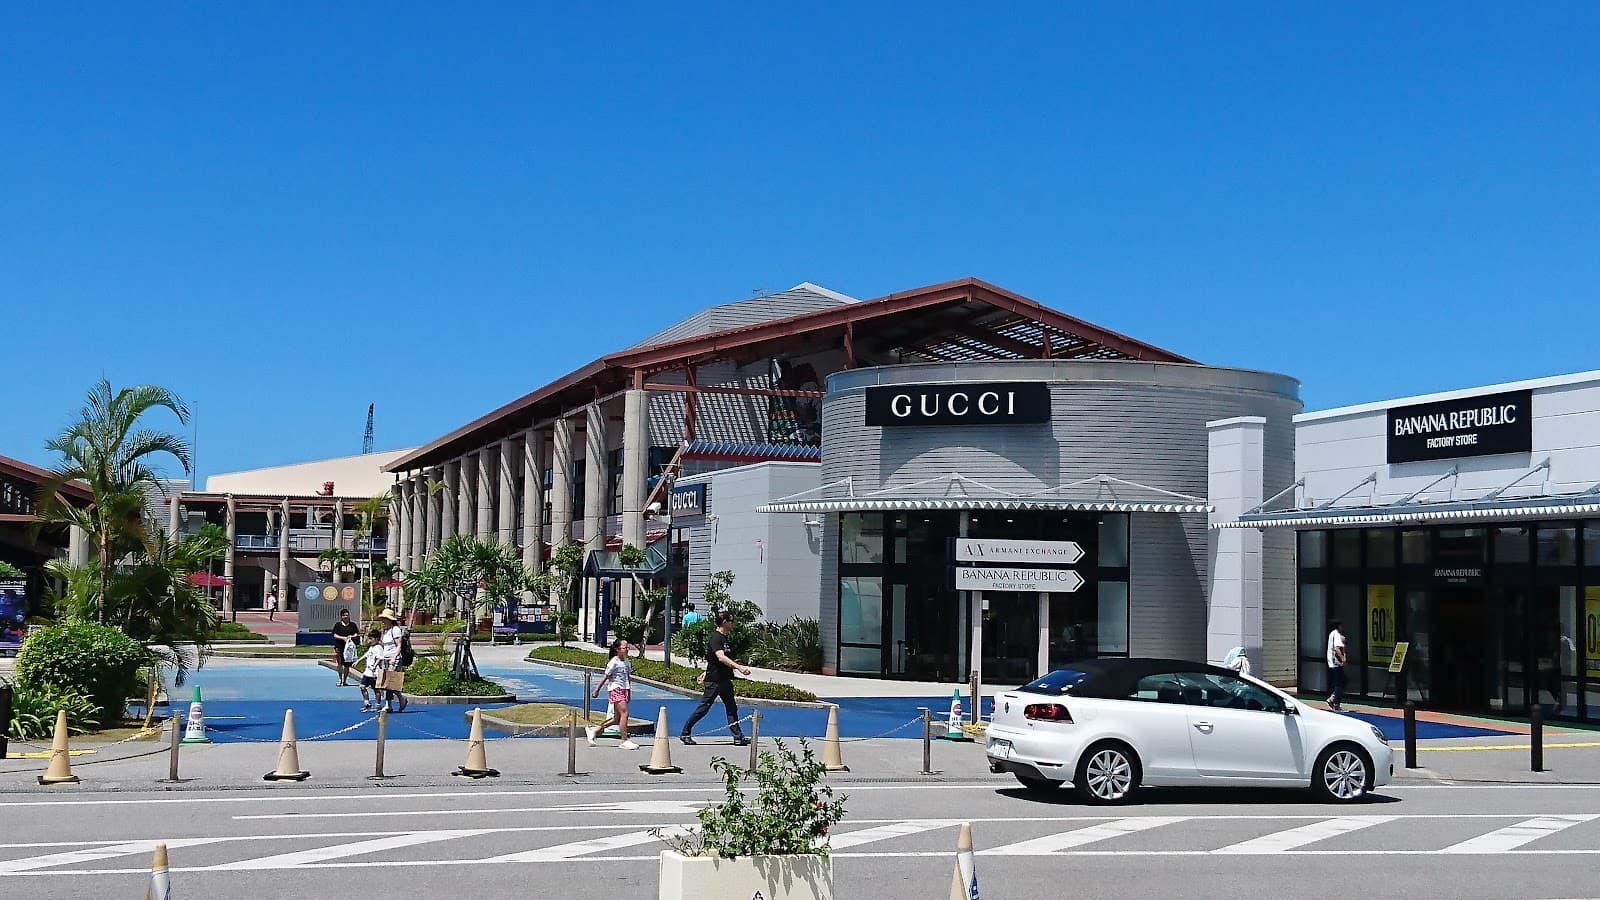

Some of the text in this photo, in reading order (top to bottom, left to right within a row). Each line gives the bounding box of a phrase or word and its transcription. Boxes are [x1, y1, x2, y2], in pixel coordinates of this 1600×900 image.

[891, 391, 1015, 417] GUCCI
[1395, 404, 1516, 436] BANANA REPUBLIC
[1426, 433, 1478, 449] FACTORY STORE
[672, 490, 698, 510] GUCCI
[1025, 548, 1067, 556] EXCHANGE
[962, 569, 1067, 582] BANANA REPUBLIC
[992, 582, 1016, 590] FACTORY
